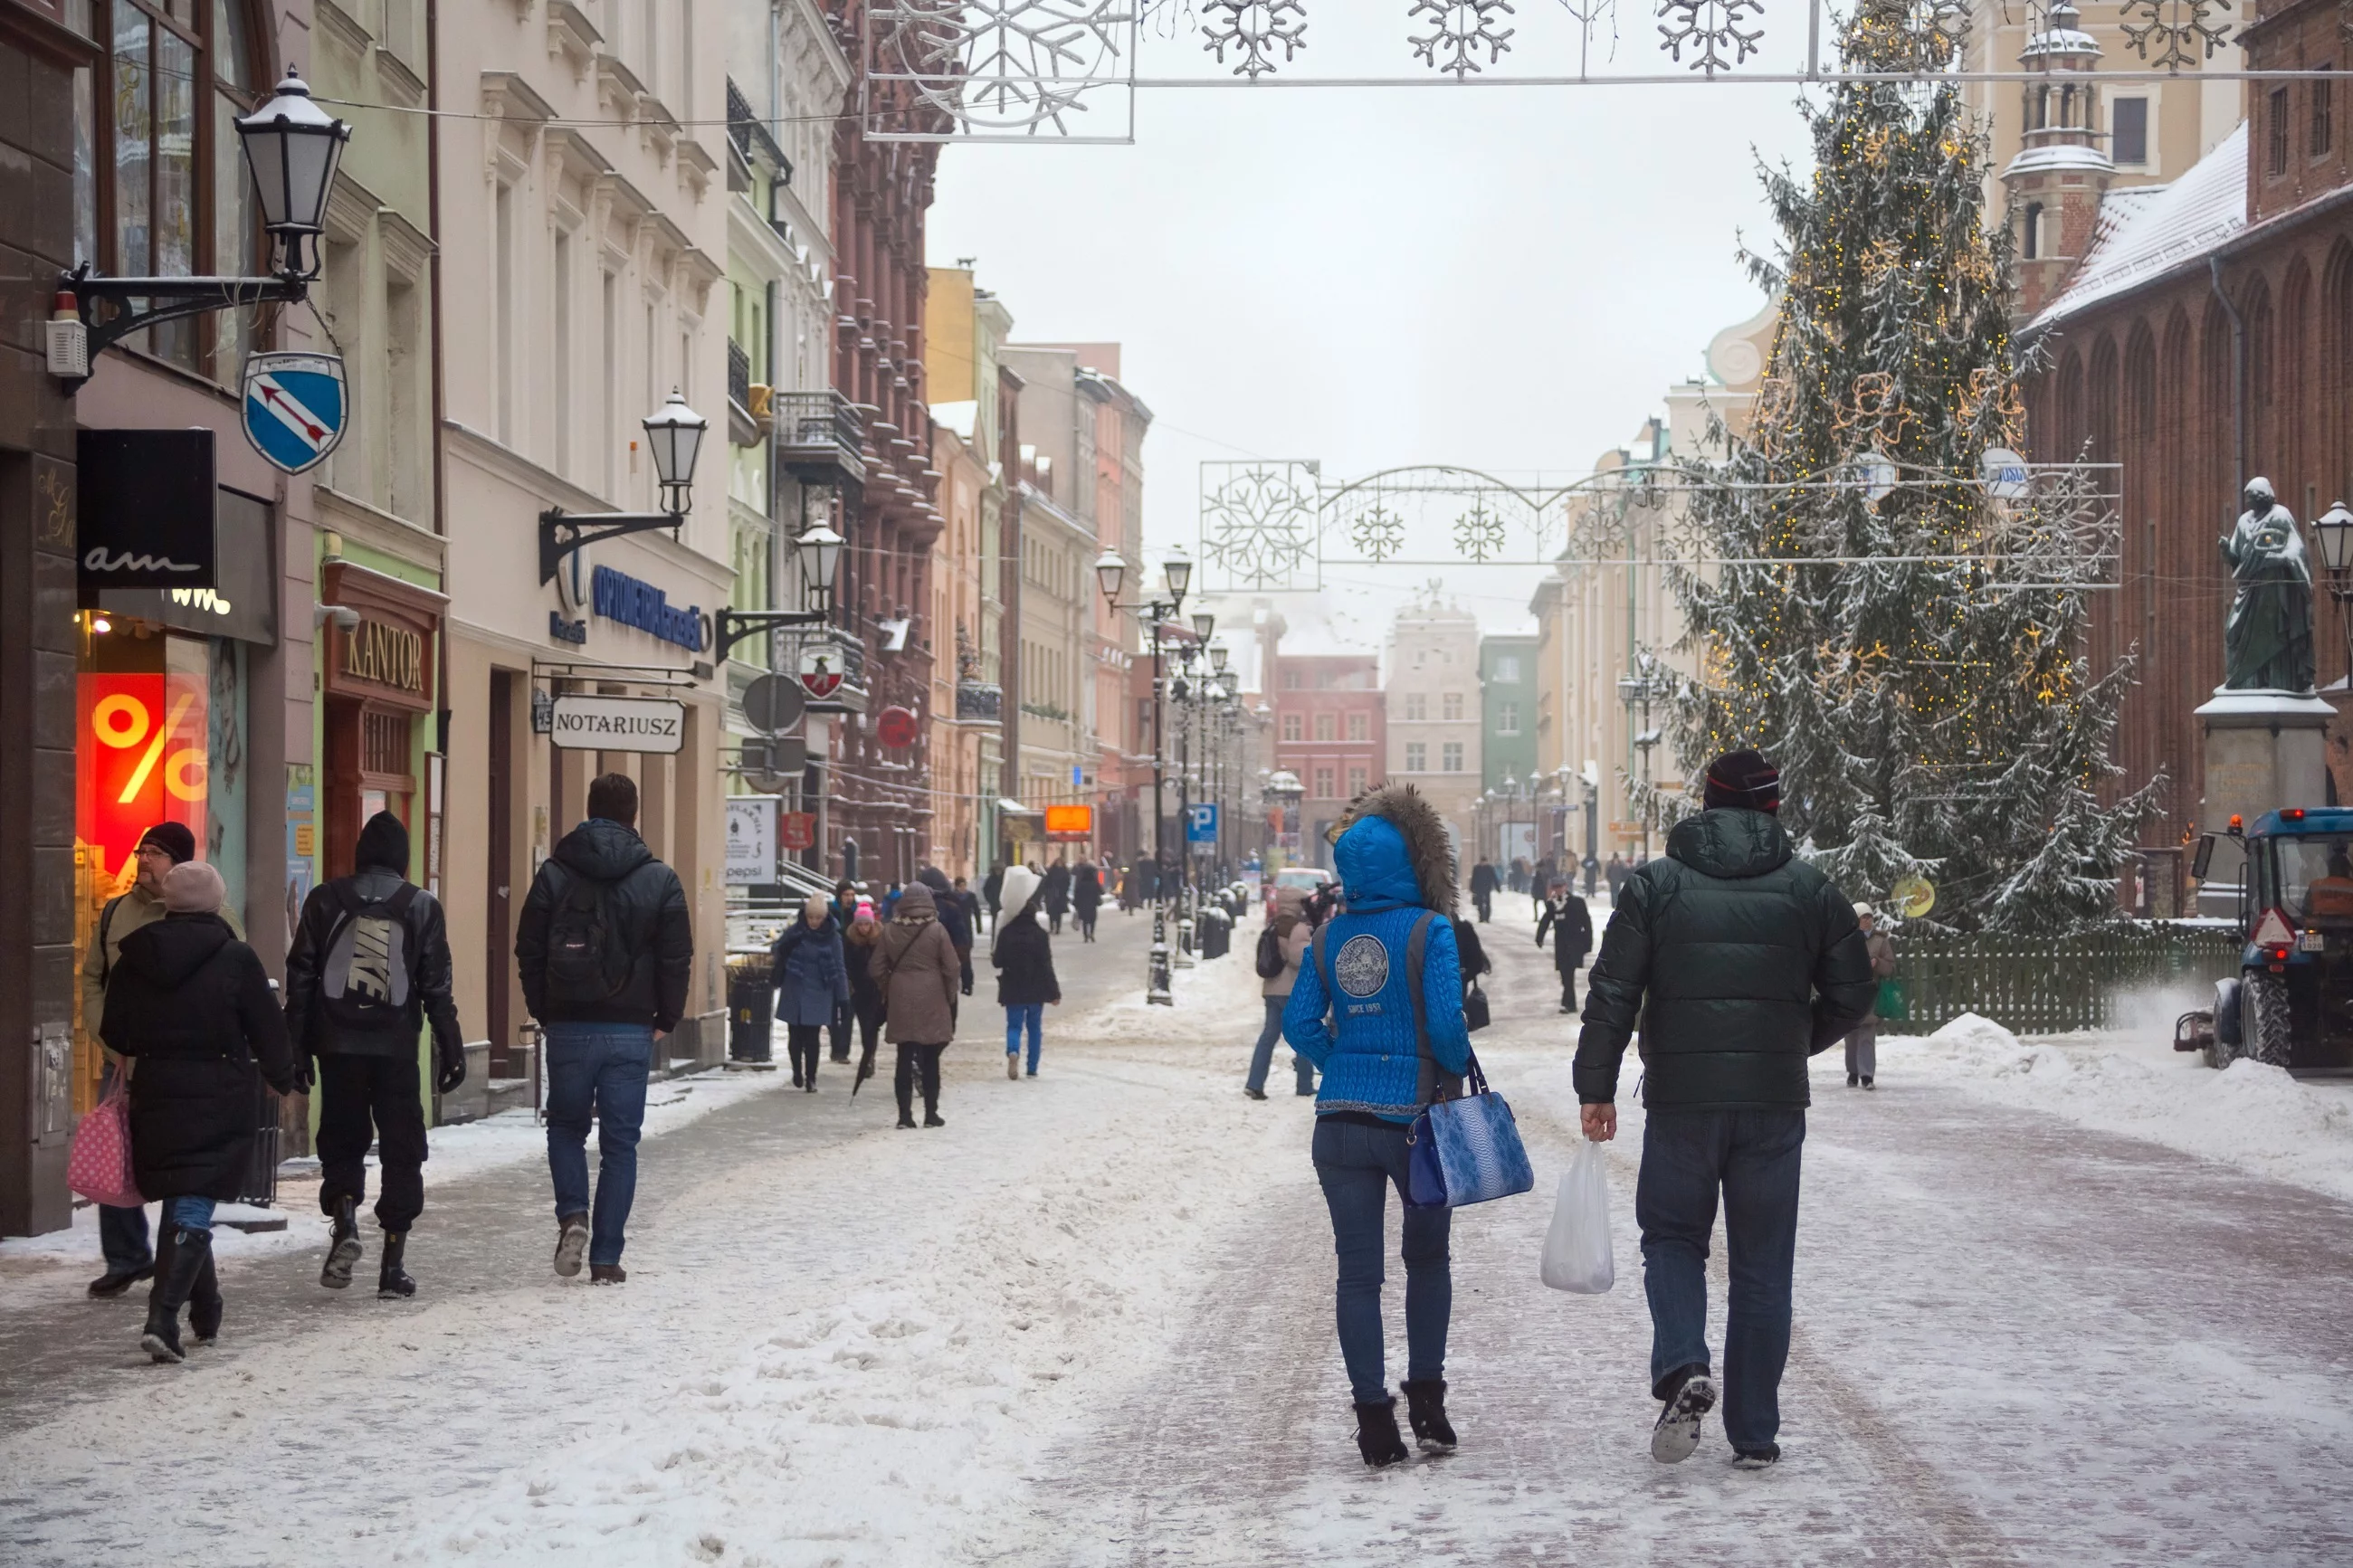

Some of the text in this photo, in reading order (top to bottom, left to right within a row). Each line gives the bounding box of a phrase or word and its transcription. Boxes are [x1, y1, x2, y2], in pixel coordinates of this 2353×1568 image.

[348, 620, 424, 691] KANTOR
[557, 713, 678, 736] NOTARIUSZ
[1194, 807, 1212, 831] P
[727, 866, 762, 878] pepsi
[348, 915, 390, 1003] NIKE
